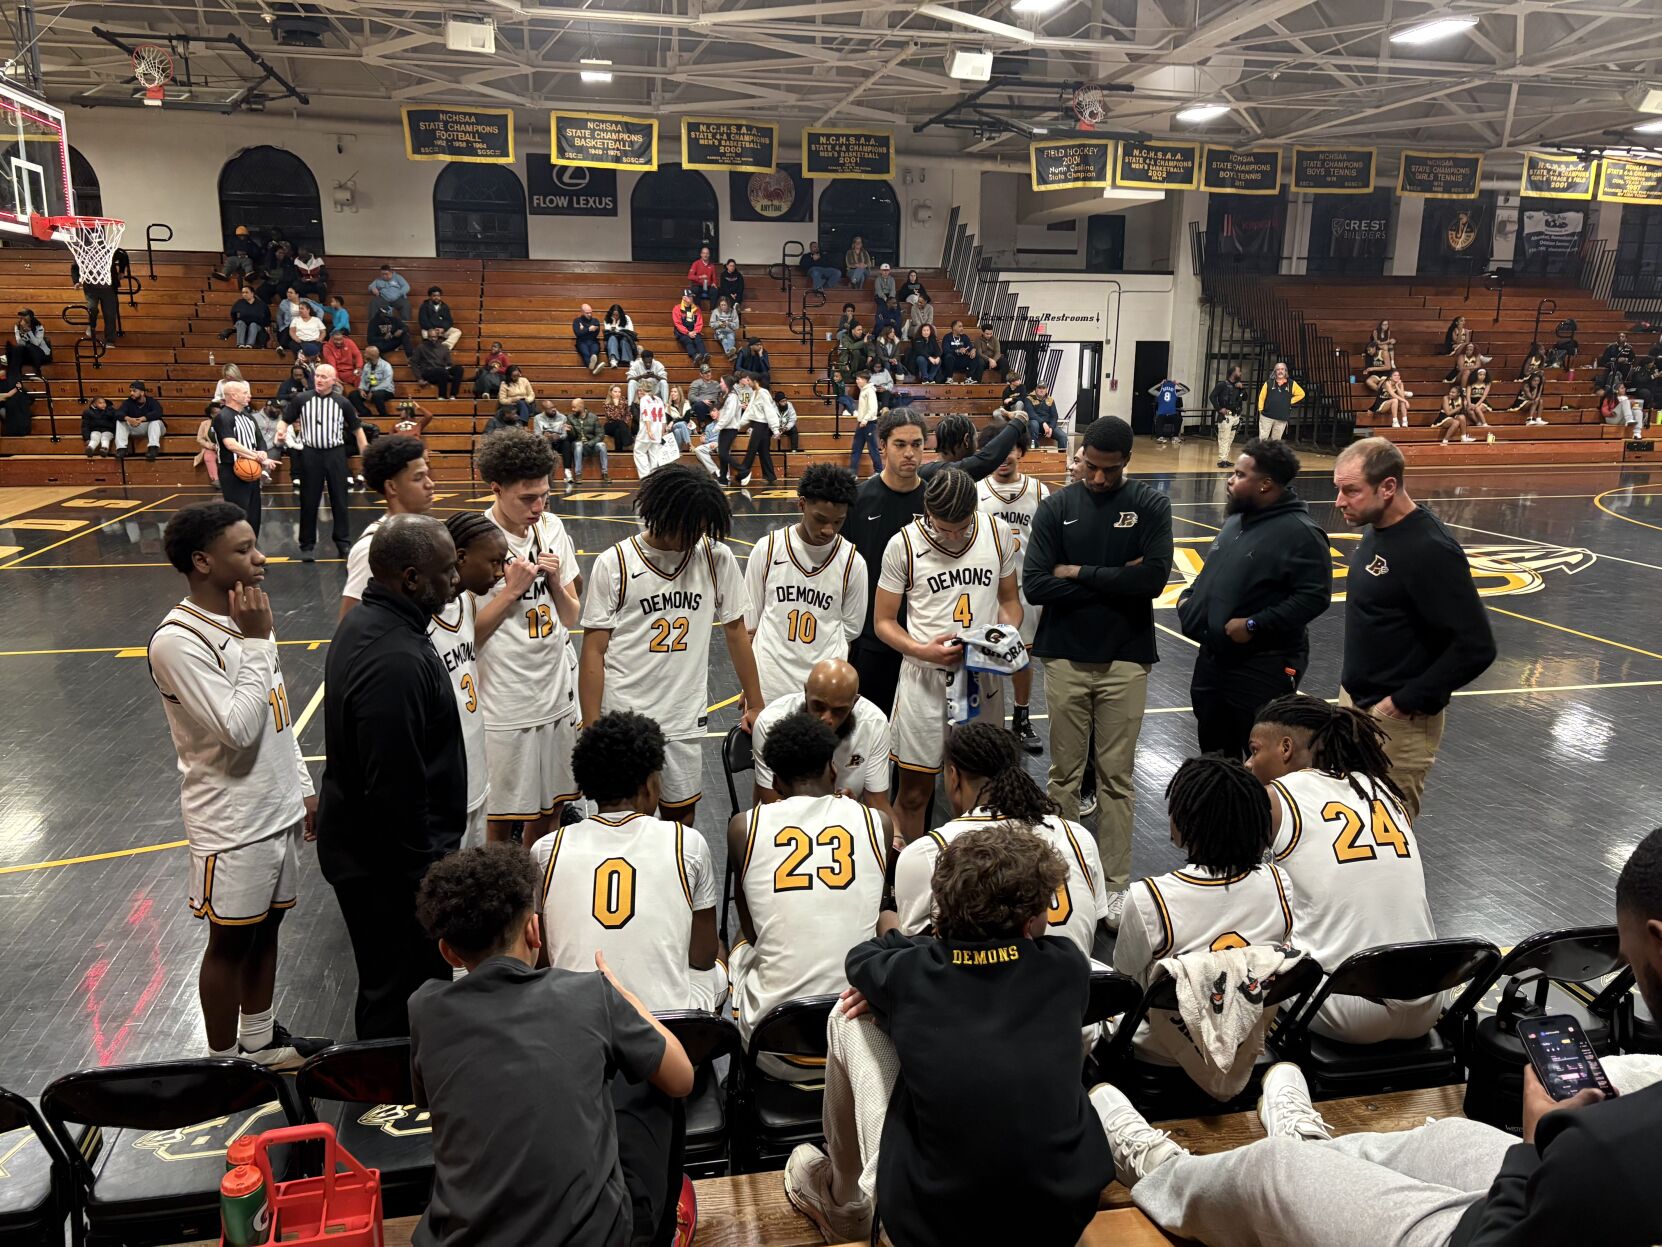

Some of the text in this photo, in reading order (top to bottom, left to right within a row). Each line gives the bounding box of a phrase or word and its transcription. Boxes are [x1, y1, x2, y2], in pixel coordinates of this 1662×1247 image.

[440, 113, 476, 122] NCHSAA
[448, 123, 498, 134] CHAMPIONS
[588, 122, 622, 131] NCHSAA
[436, 130, 482, 141] FOOTBALL
[567, 128, 642, 142] STATE CHAMPIONS
[574, 138, 631, 150] BASKETBALL
[722, 140, 761, 148] BASKETBALL
[731, 134, 769, 144] CHAMPIONS
[1044, 147, 1098, 157] FIELD HOCKEY
[533, 196, 613, 208] FLOW LEXUS
[1344, 220, 1386, 230] CREST
[927, 568, 993, 594] DEMONS
[640, 591, 702, 616] DEMONS
[776, 586, 833, 611] DEMONS
[526, 604, 553, 639] 12
[953, 593, 973, 628] 4
[649, 616, 689, 652] 22
[787, 609, 817, 644] 10
[460, 673, 478, 713] 3
[269, 683, 290, 733] 11
[1320, 799, 1411, 864] 24
[774, 825, 856, 893] 23
[592, 856, 636, 930] 0
[952, 945, 1020, 966] DEMONS
